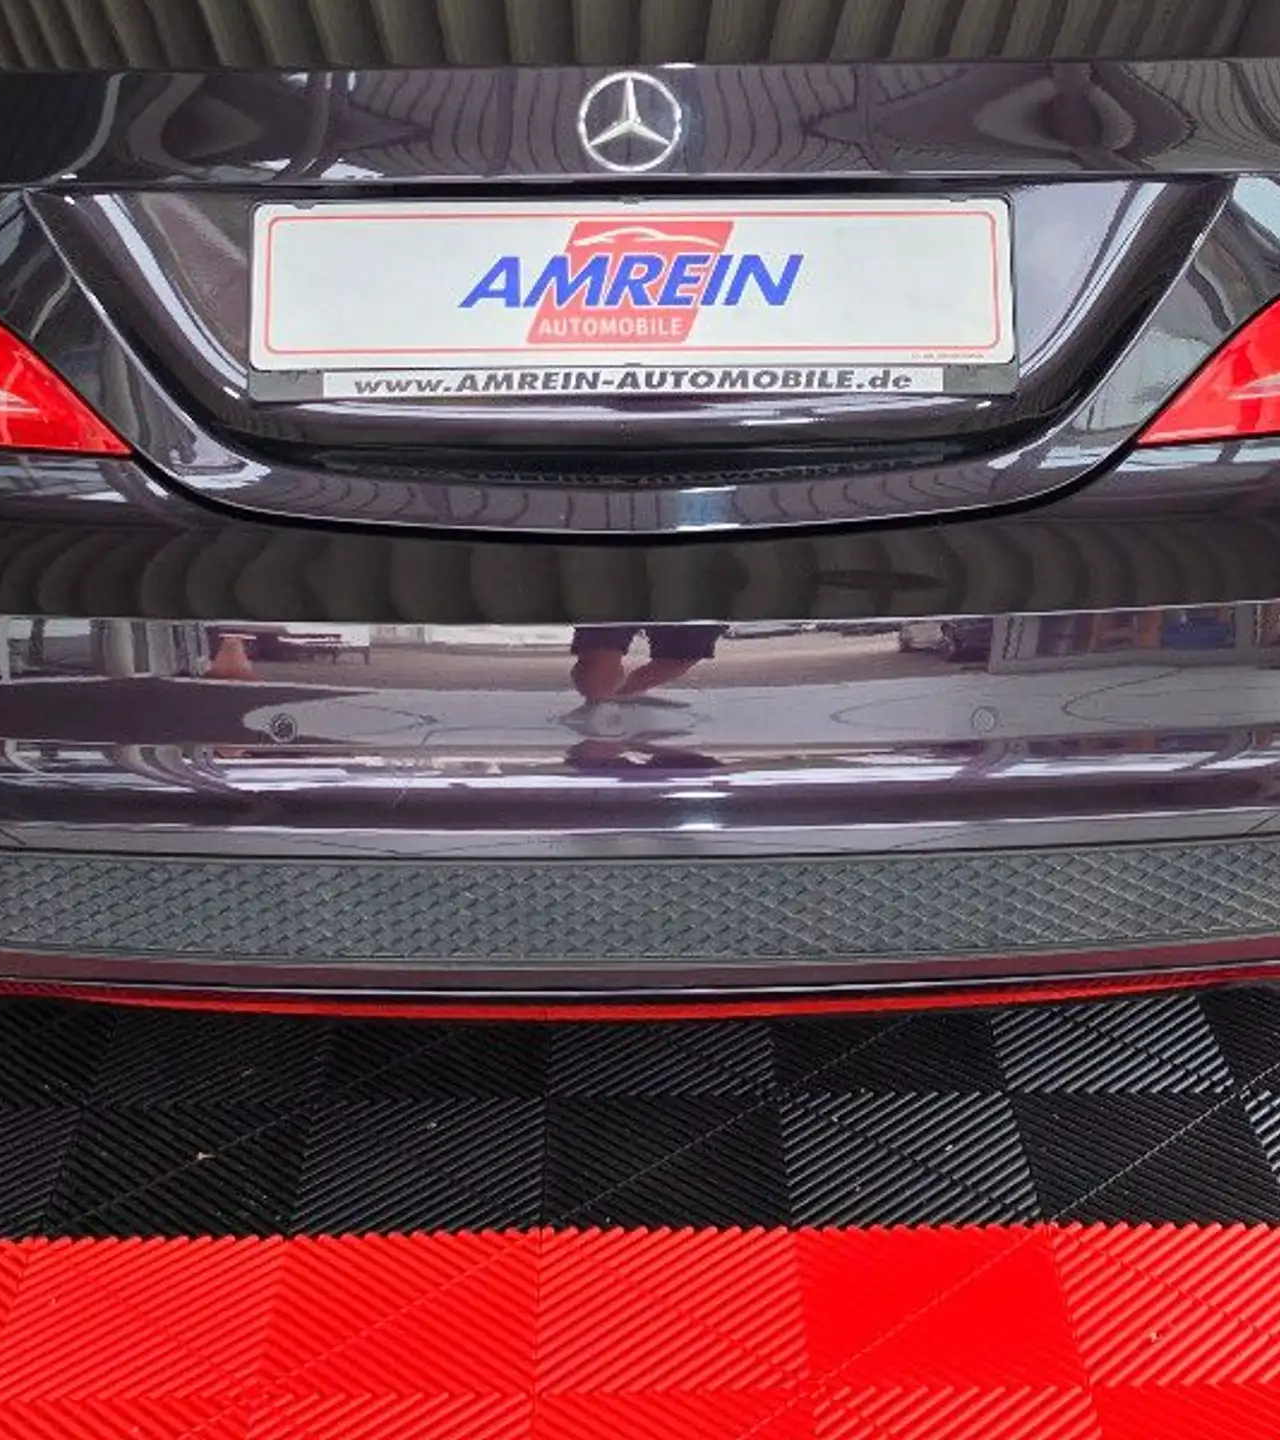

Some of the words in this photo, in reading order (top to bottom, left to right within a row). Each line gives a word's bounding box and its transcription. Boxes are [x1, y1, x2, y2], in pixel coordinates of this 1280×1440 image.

[457, 253, 805, 309] AMREIN
[536, 316, 684, 337] AUTOMOBILE
[353, 368, 913, 394] www.AMREIN-AUTOMOBILE.de
